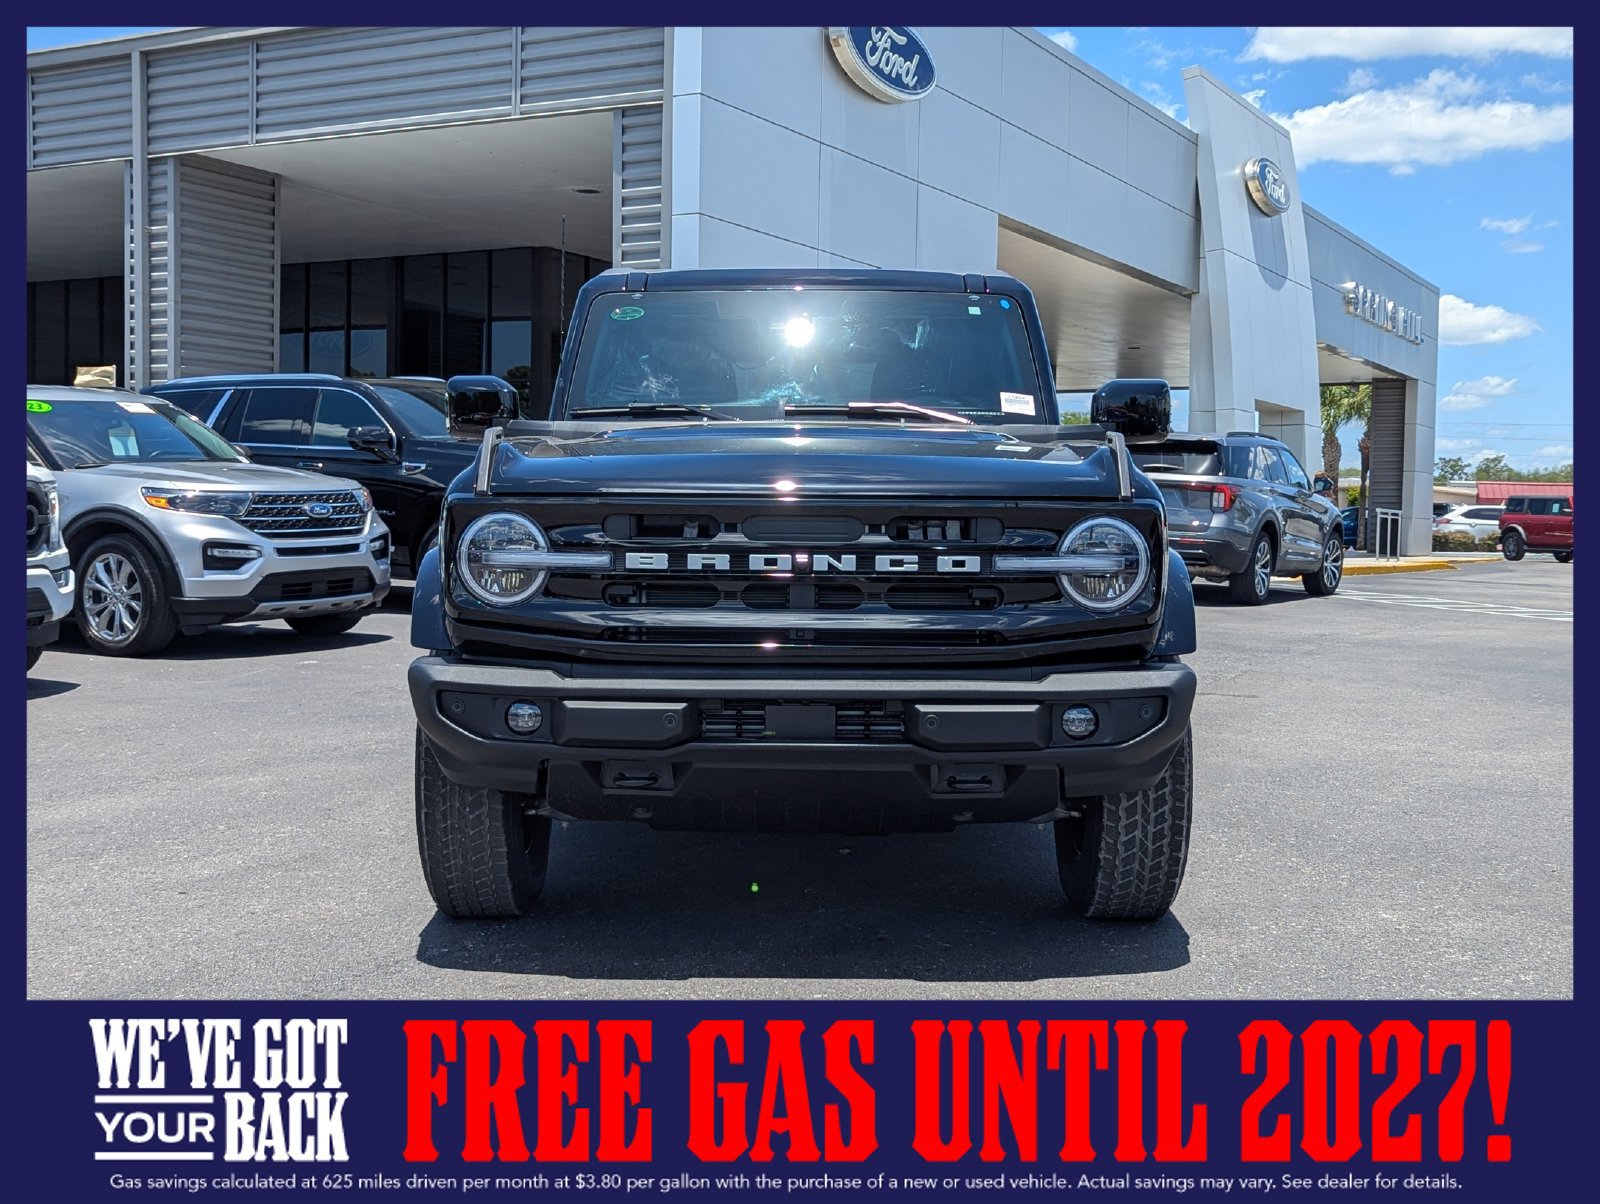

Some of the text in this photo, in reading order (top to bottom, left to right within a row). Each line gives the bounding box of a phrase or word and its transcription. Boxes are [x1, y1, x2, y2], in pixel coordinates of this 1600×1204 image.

[866, 27, 920, 87] Ford
[1265, 167, 1286, 204] Ford
[1342, 281, 1424, 344] SPRING HILL
[625, 552, 981, 572] BRONCO
